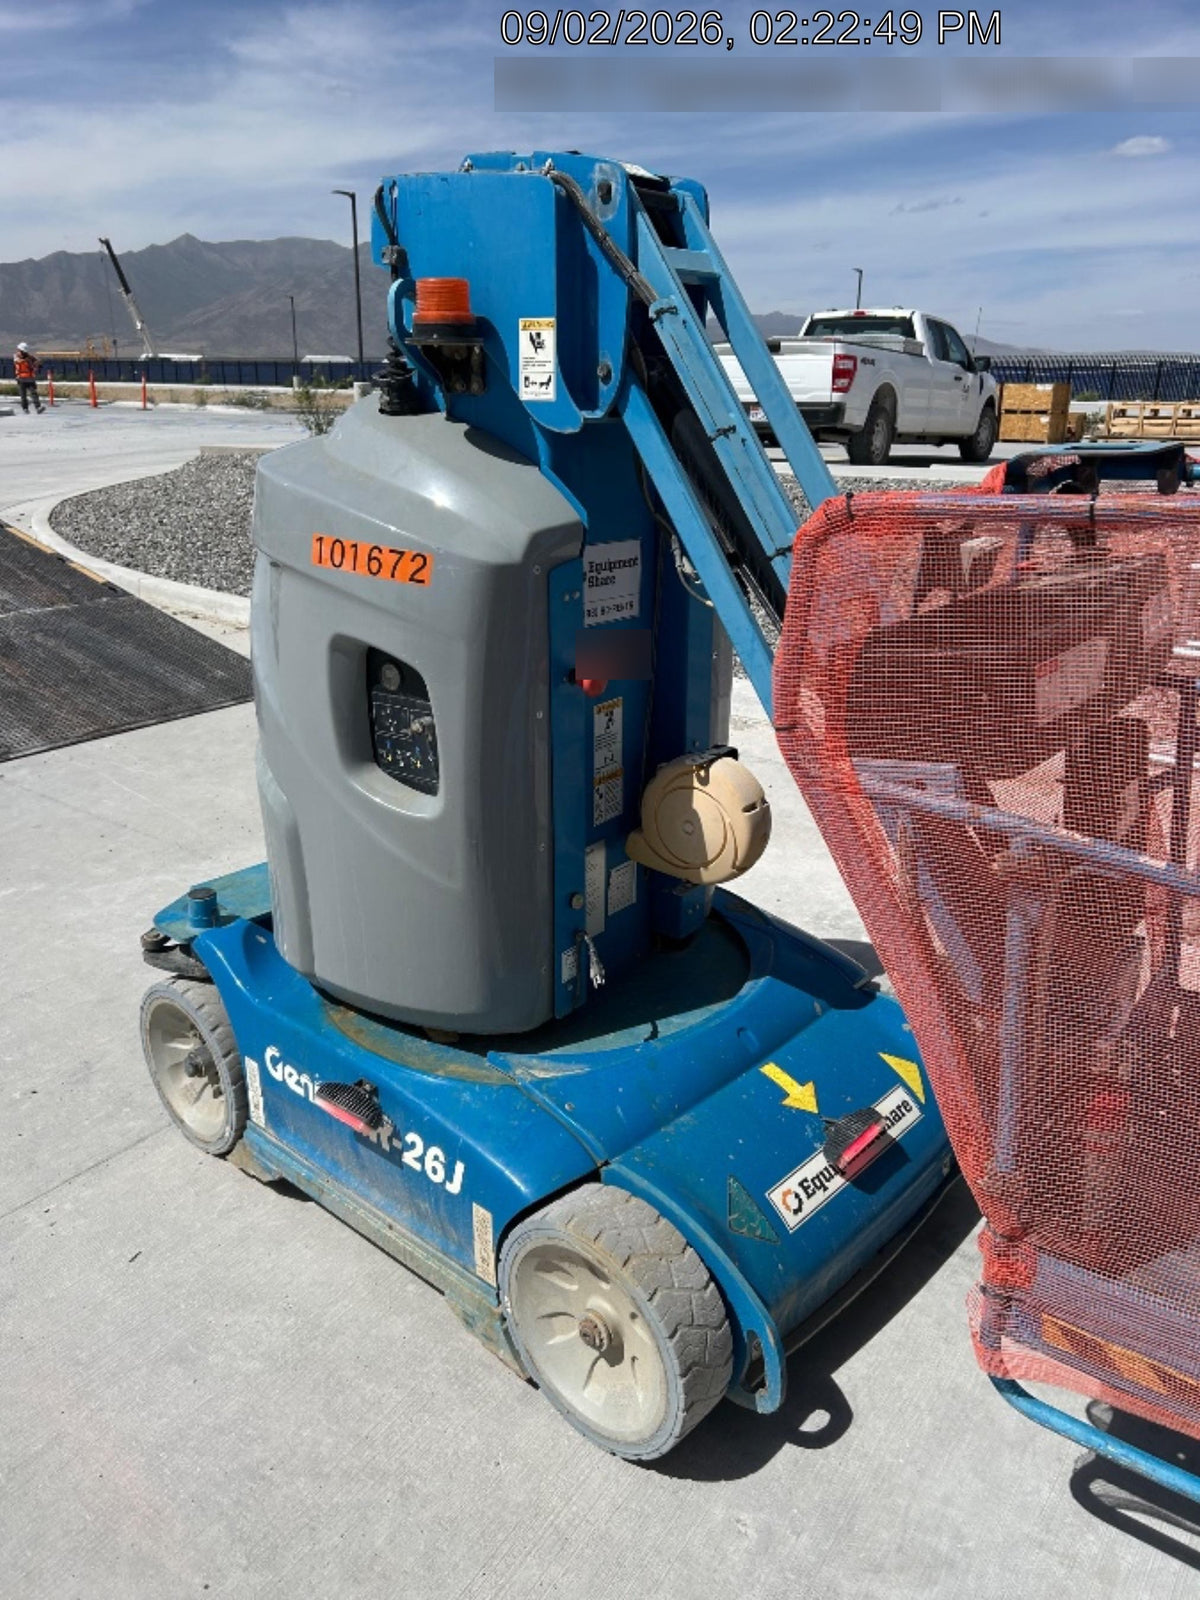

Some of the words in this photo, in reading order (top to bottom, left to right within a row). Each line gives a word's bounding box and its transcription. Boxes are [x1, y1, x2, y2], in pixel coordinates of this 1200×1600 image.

[315, 536, 427, 584] 101672
[587, 556, 639, 575] Equipment
[587, 575, 616, 588] Share
